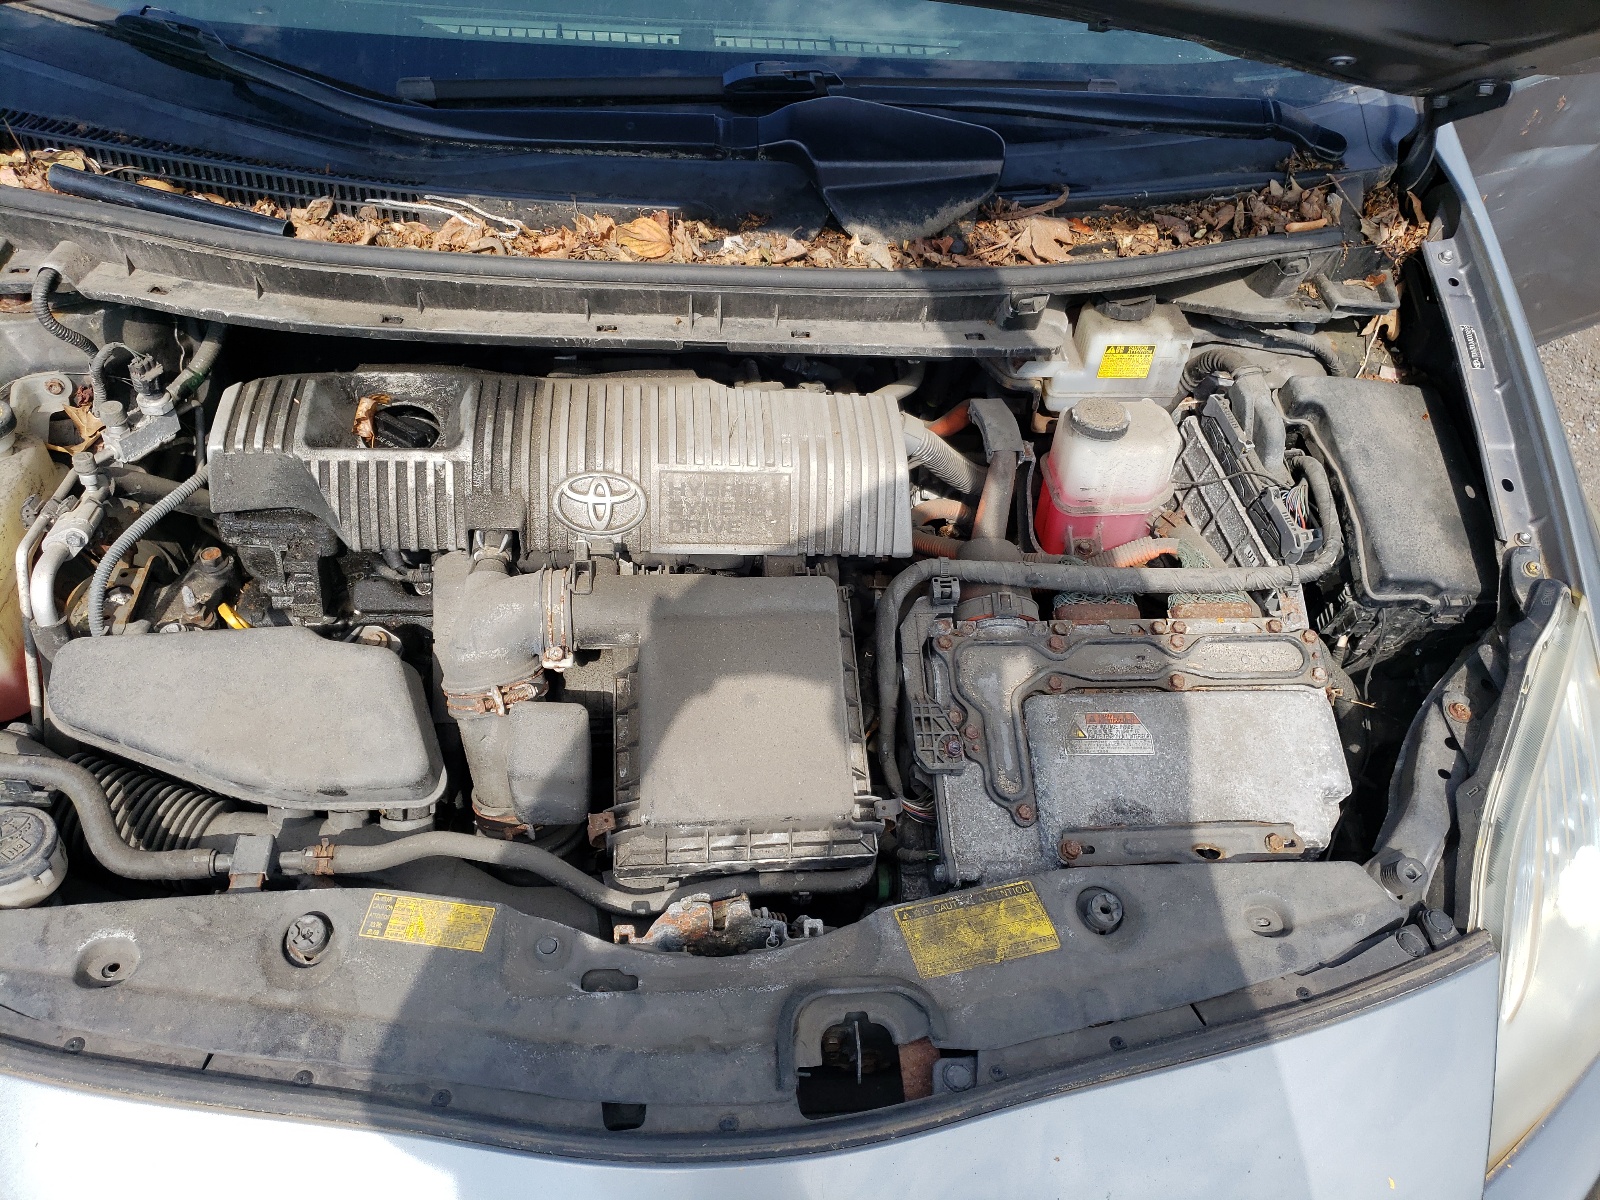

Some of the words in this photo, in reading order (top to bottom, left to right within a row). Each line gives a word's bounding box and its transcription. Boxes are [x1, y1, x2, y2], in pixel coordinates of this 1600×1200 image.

[668, 481, 763, 498] HYBRID
[668, 518, 743, 534] DRIVE
[933, 897, 976, 913] CAUT
